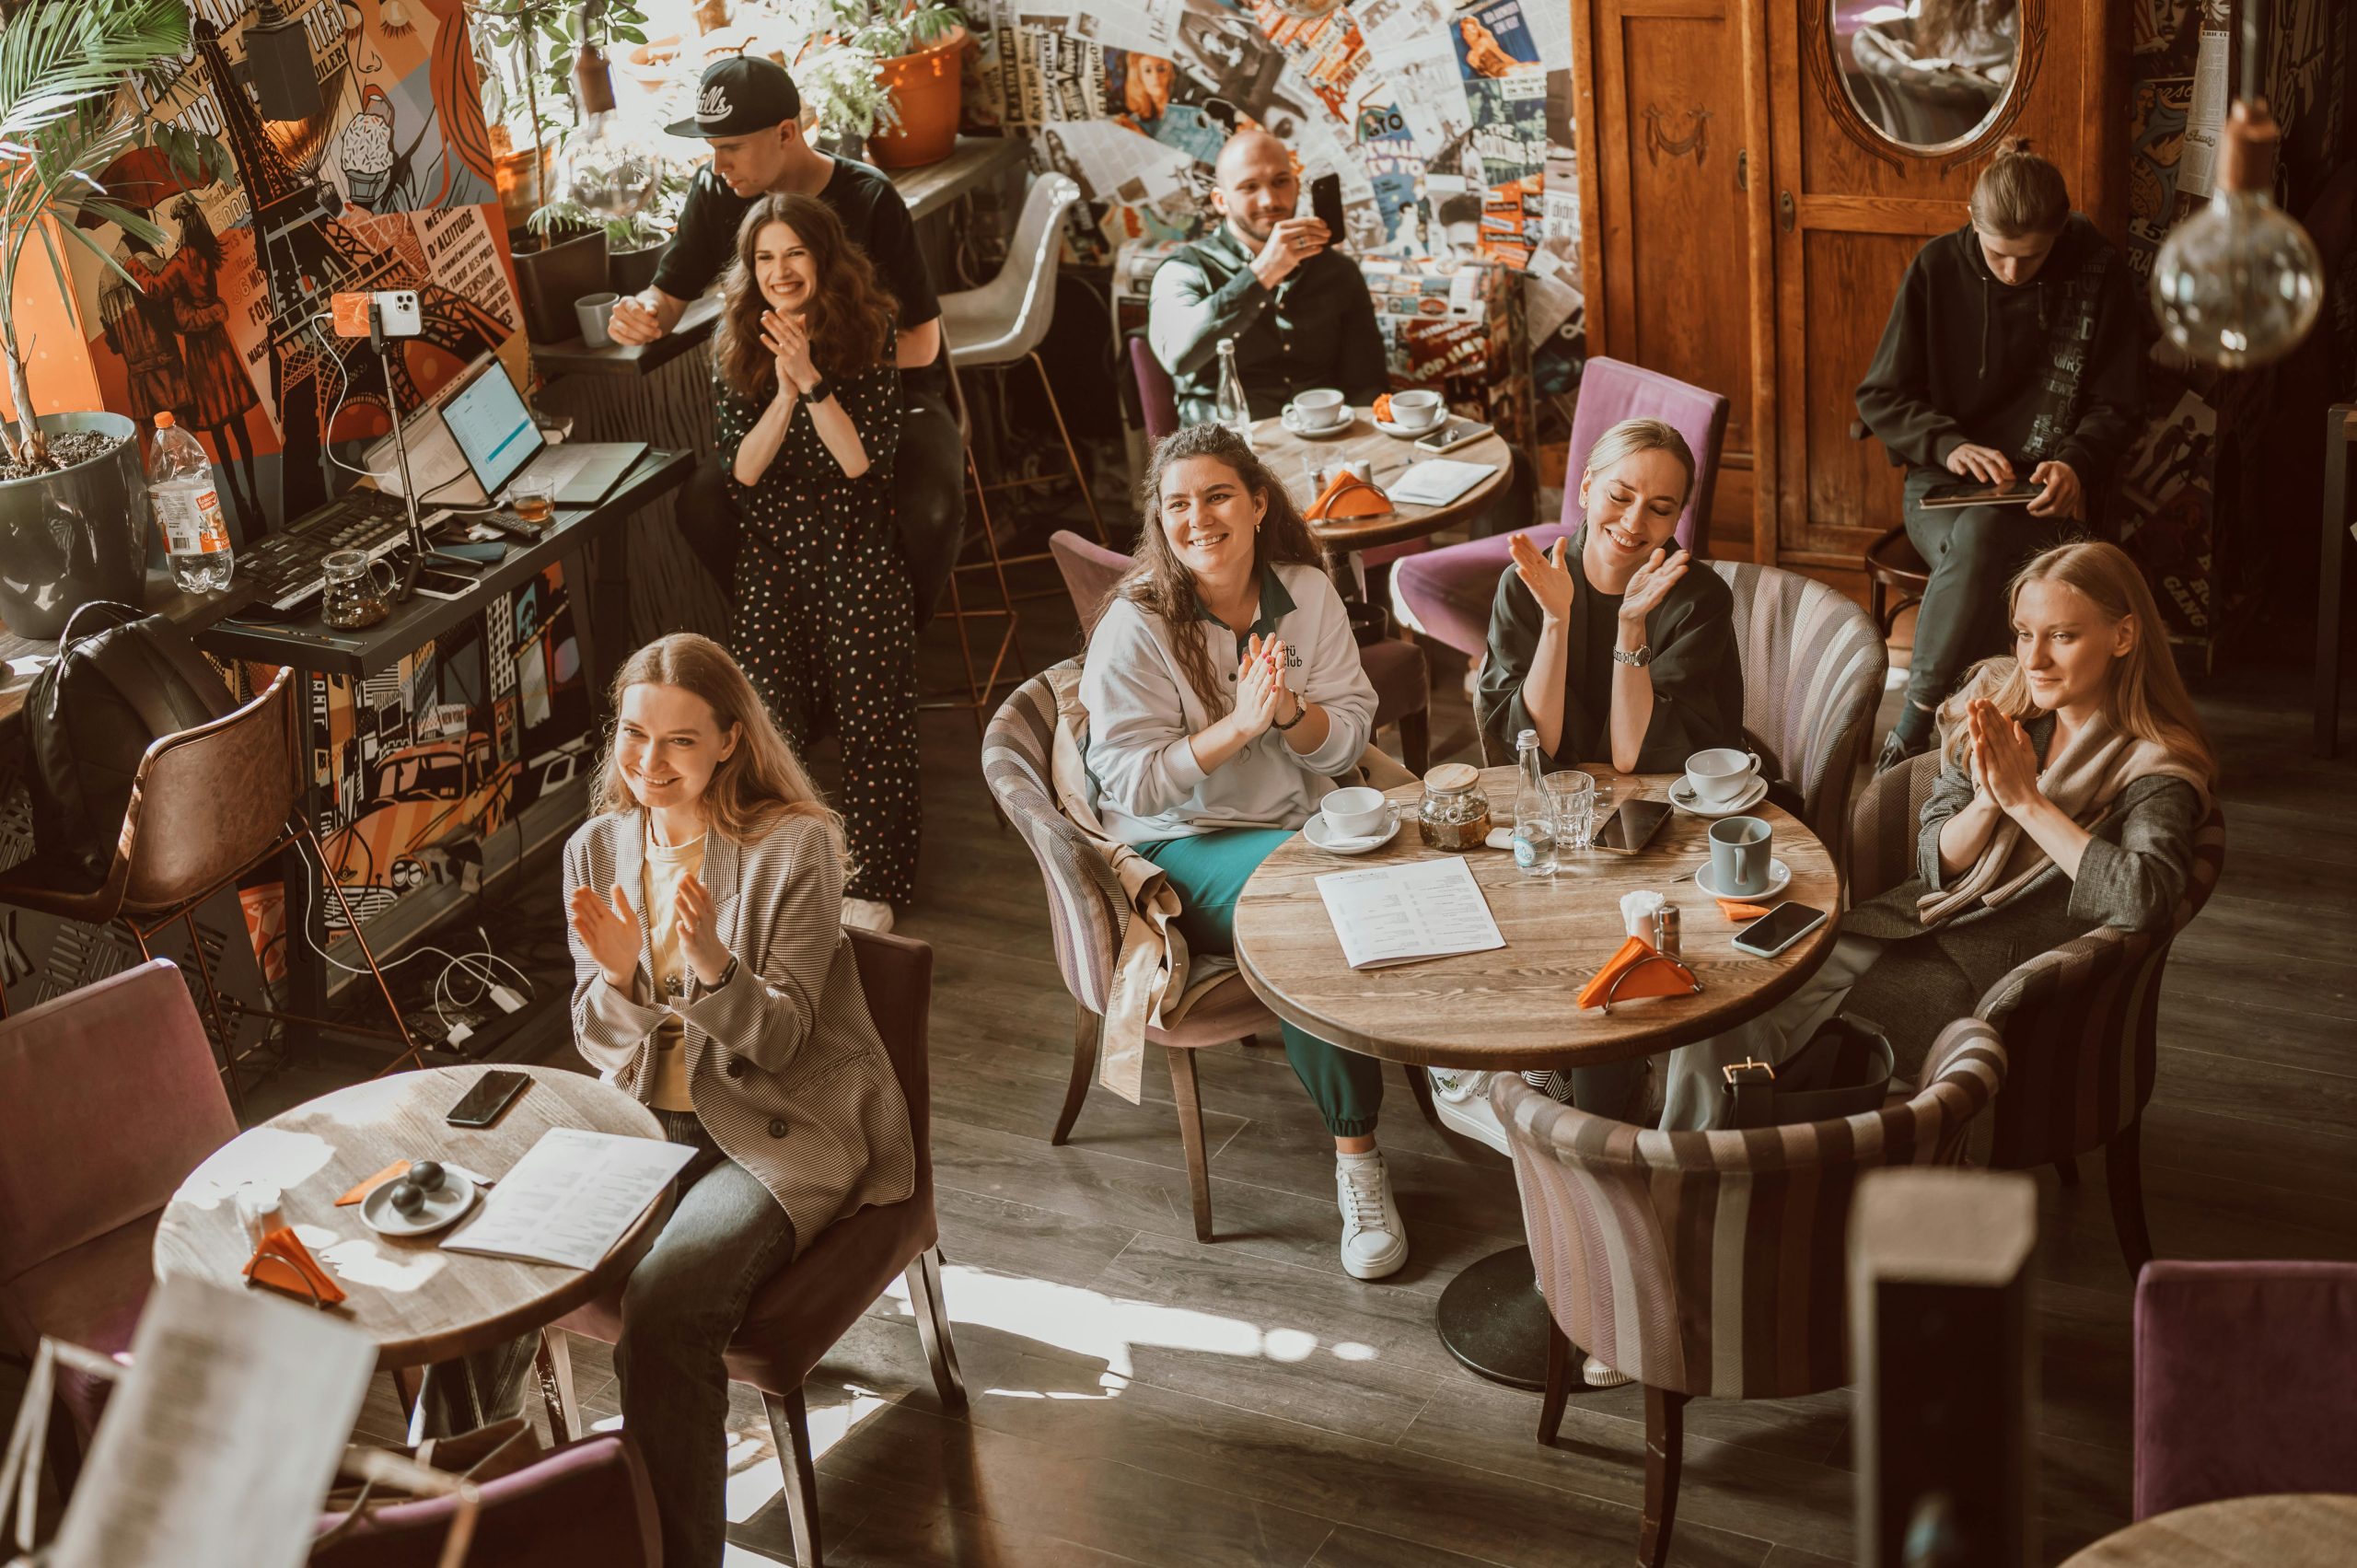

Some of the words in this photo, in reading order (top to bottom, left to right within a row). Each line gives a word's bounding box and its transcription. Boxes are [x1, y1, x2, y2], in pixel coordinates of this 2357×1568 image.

[1000, 29, 1015, 55] FAIR
[427, 208, 475, 261] D'ALTITUDE
[438, 229, 486, 277] COMMÉMORATIVE
[449, 266, 469, 289] TARIF
[468, 255, 481, 273] DES
[479, 243, 495, 265] PRIX
[232, 278, 250, 305] 36
[2165, 576, 2207, 626] GANG
